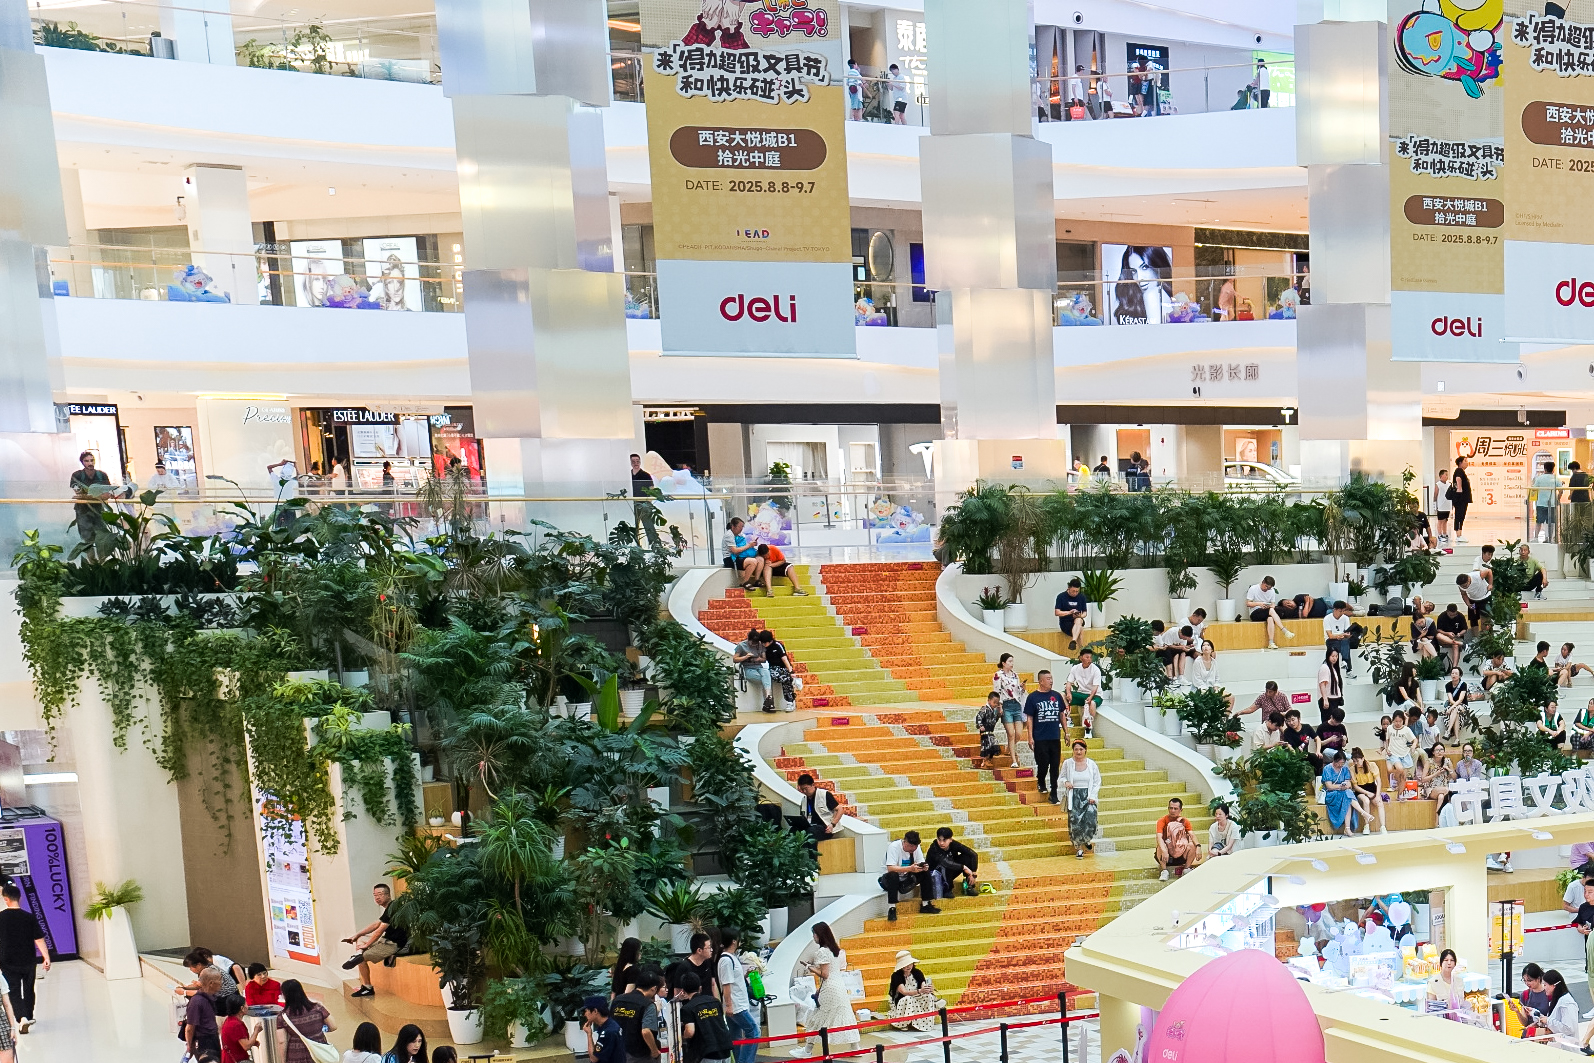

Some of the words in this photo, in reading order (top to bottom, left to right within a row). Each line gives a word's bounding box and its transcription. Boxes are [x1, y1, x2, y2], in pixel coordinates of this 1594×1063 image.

[679, 74, 806, 100] 和快乐碰头
[697, 130, 798, 148] 西安大悦城B1
[717, 150, 781, 167] 拾光中庭
[1532, 157, 1564, 170] DATE:
[1412, 157, 1494, 178] 和快乐碰头
[685, 179, 723, 191] DATE:
[728, 180, 816, 194] 2025.8.8-9.7
[1423, 197, 1488, 212] 西安大悦城B1
[1434, 212, 1477, 226] 拾光中庭
[1412, 233, 1438, 242] DATE:
[1441, 234, 1498, 245] 2025.8.8-9.7
[719, 293, 797, 323] deli
[1431, 316, 1482, 338] deli
[1191, 363, 1260, 382] 光影长廊
[82, 405, 117, 415] LAUDER
[359, 409, 395, 422] LAUDER
[44, 826, 66, 913] 100%LUCKY
[1162, 1048, 1178, 1061] deli
